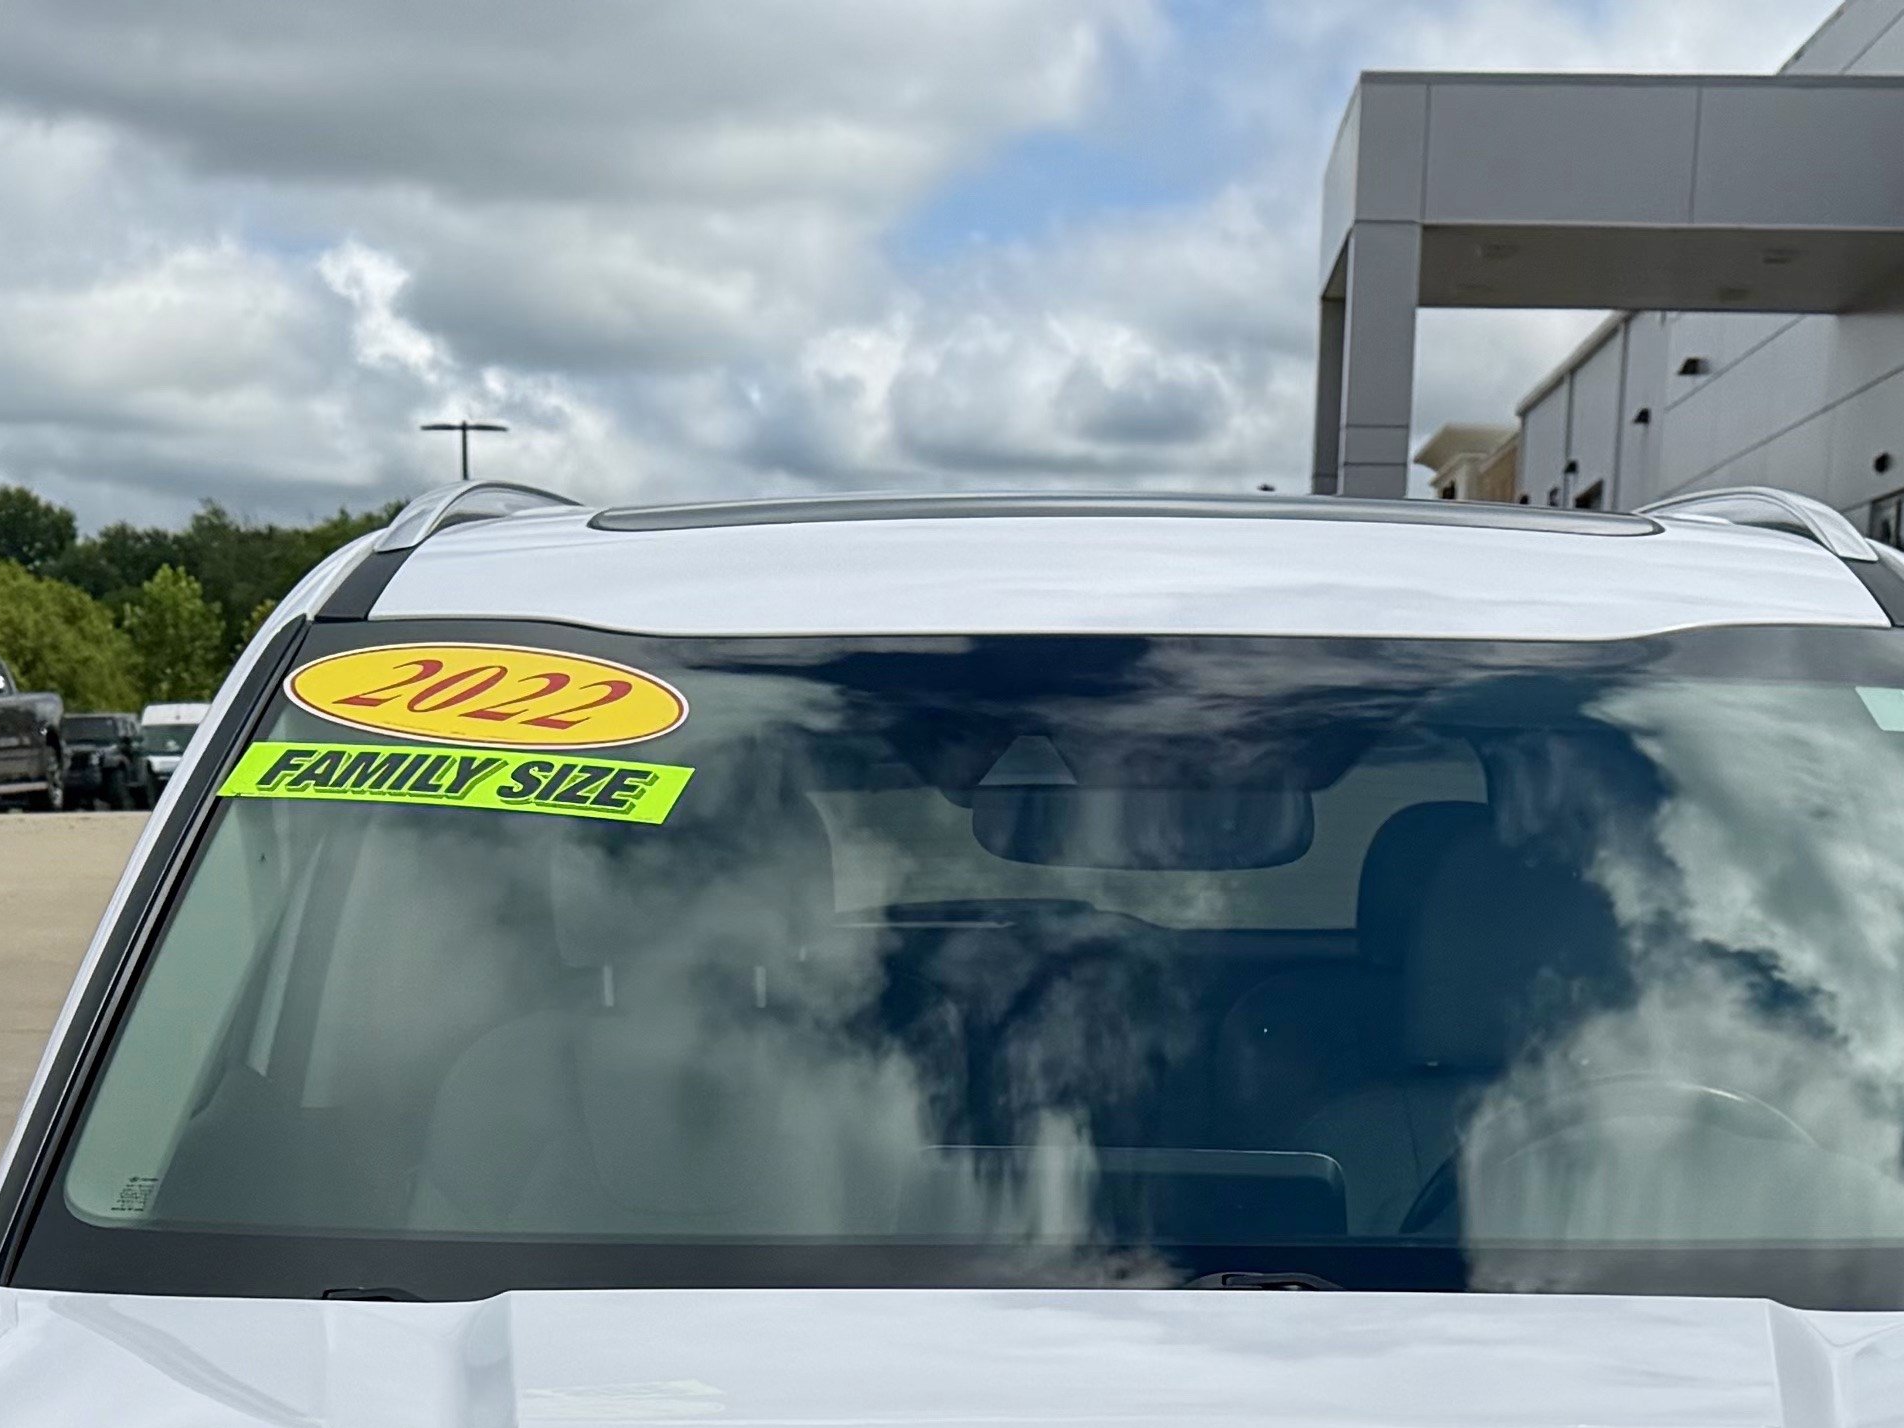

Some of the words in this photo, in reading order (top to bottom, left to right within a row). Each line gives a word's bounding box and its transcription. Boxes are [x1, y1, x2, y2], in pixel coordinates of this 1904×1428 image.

[331, 659, 634, 730] 2022
[256, 749, 509, 800] FAMILY
[495, 760, 661, 816] SIZE
